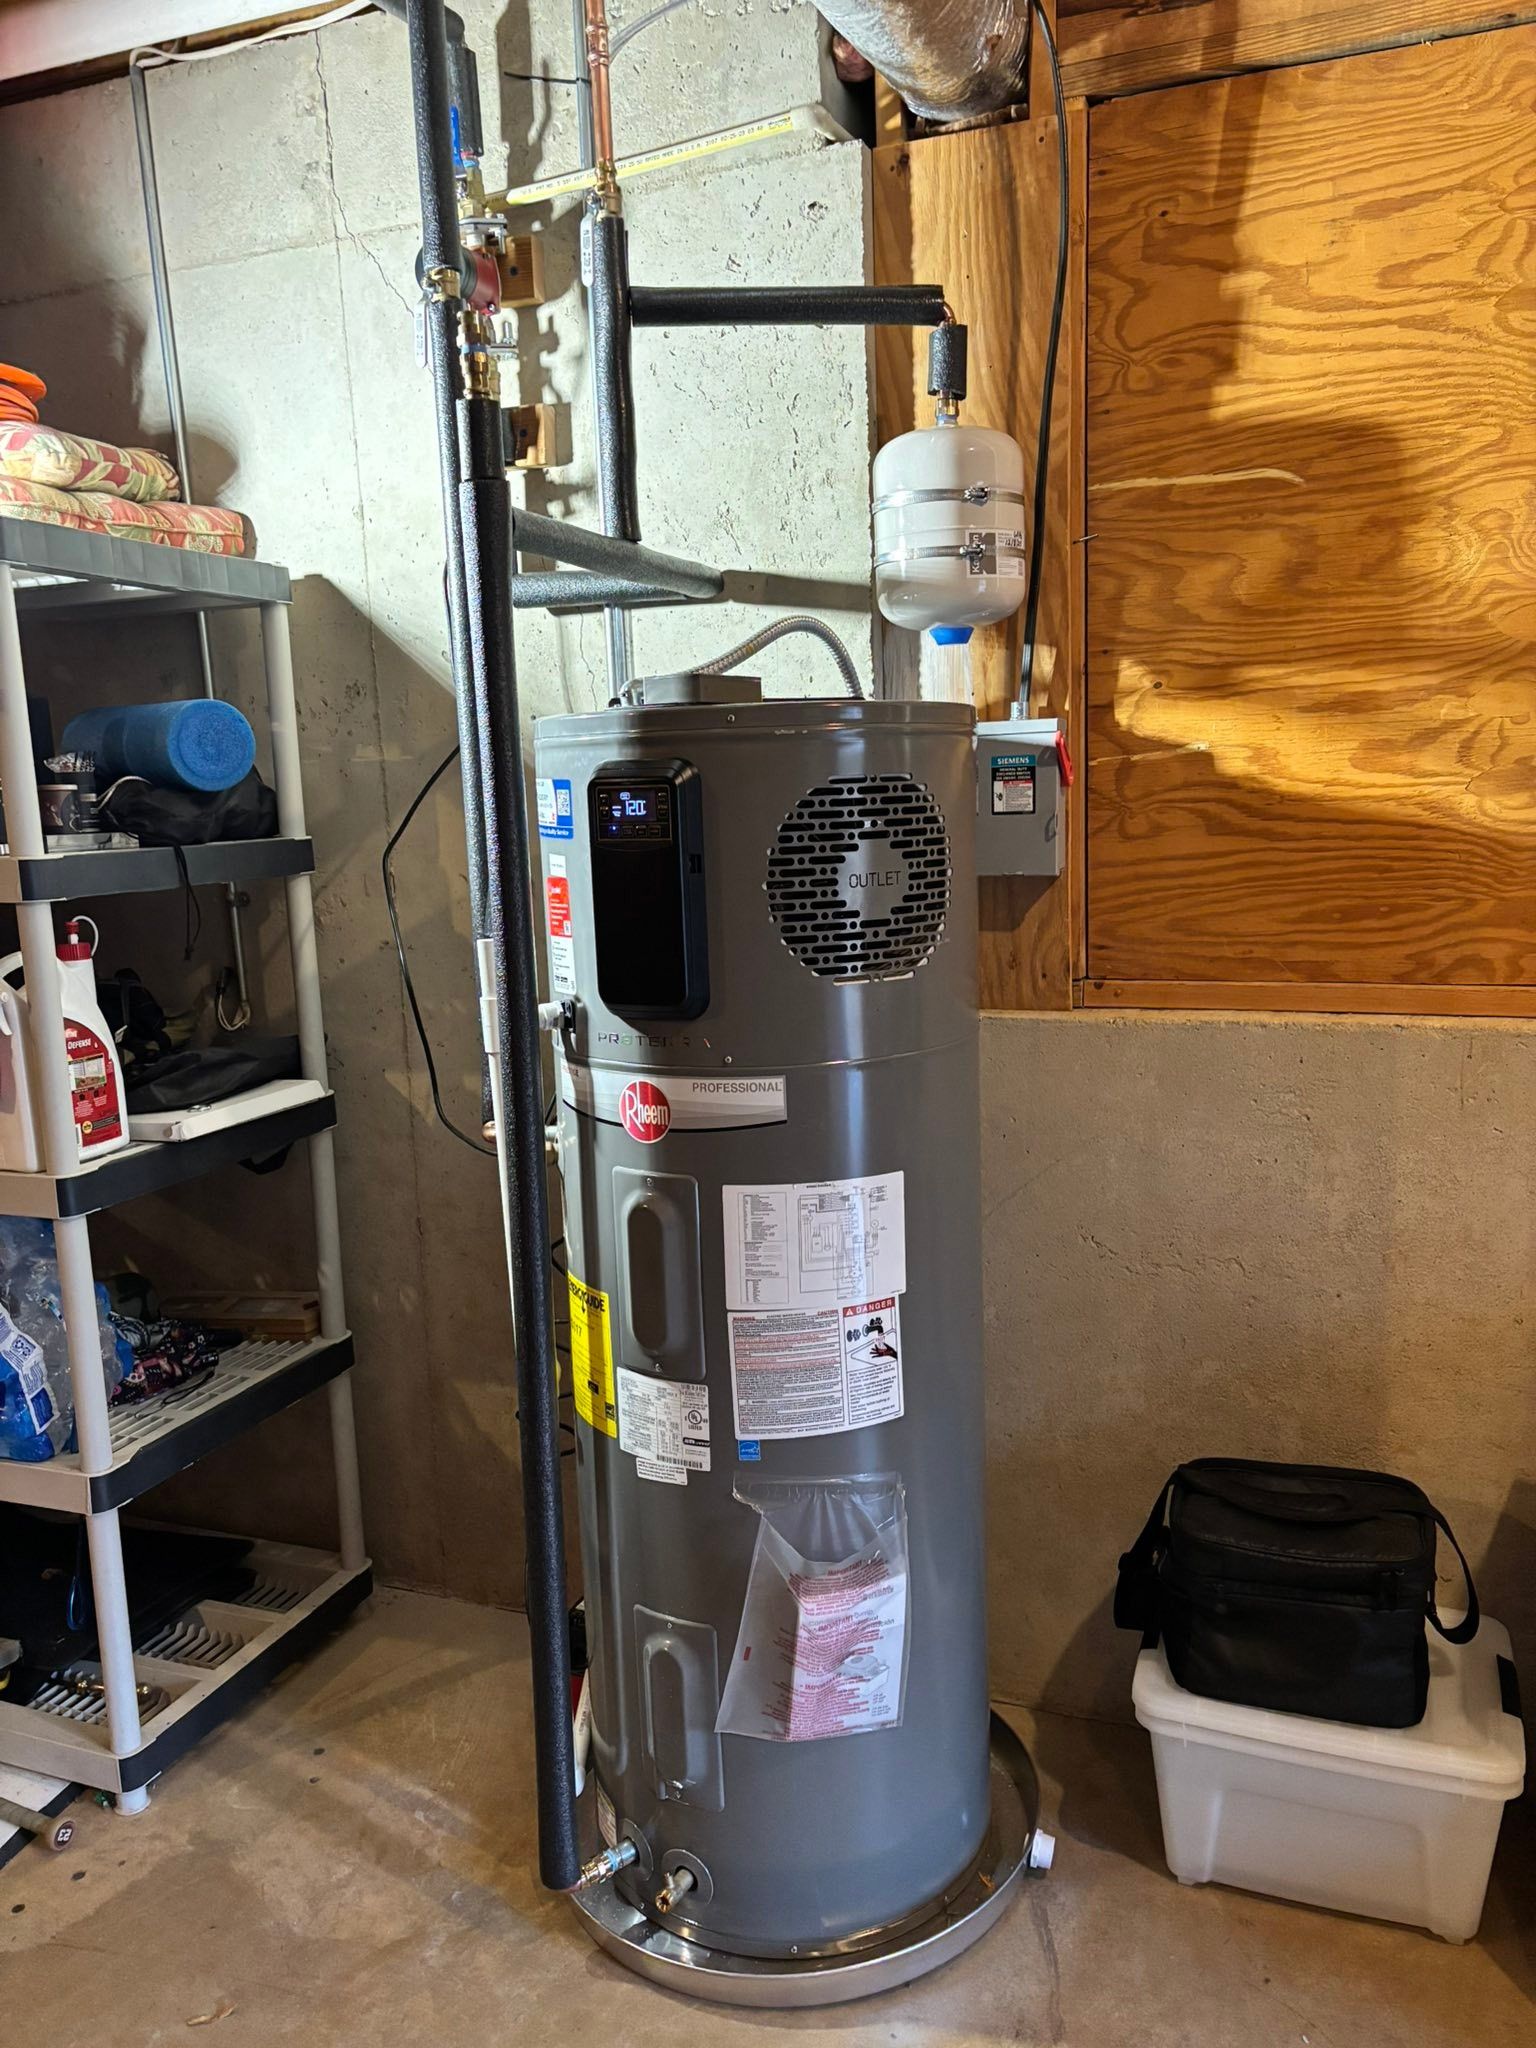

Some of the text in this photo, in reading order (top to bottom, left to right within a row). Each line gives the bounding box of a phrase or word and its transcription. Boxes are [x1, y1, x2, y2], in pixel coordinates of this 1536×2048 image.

[849, 871, 901, 888] OUTLET
[692, 1081, 782, 1094] PROFESSIONAL
[624, 1081, 669, 1133] Rheem
[855, 1299, 892, 1314] DANGER
